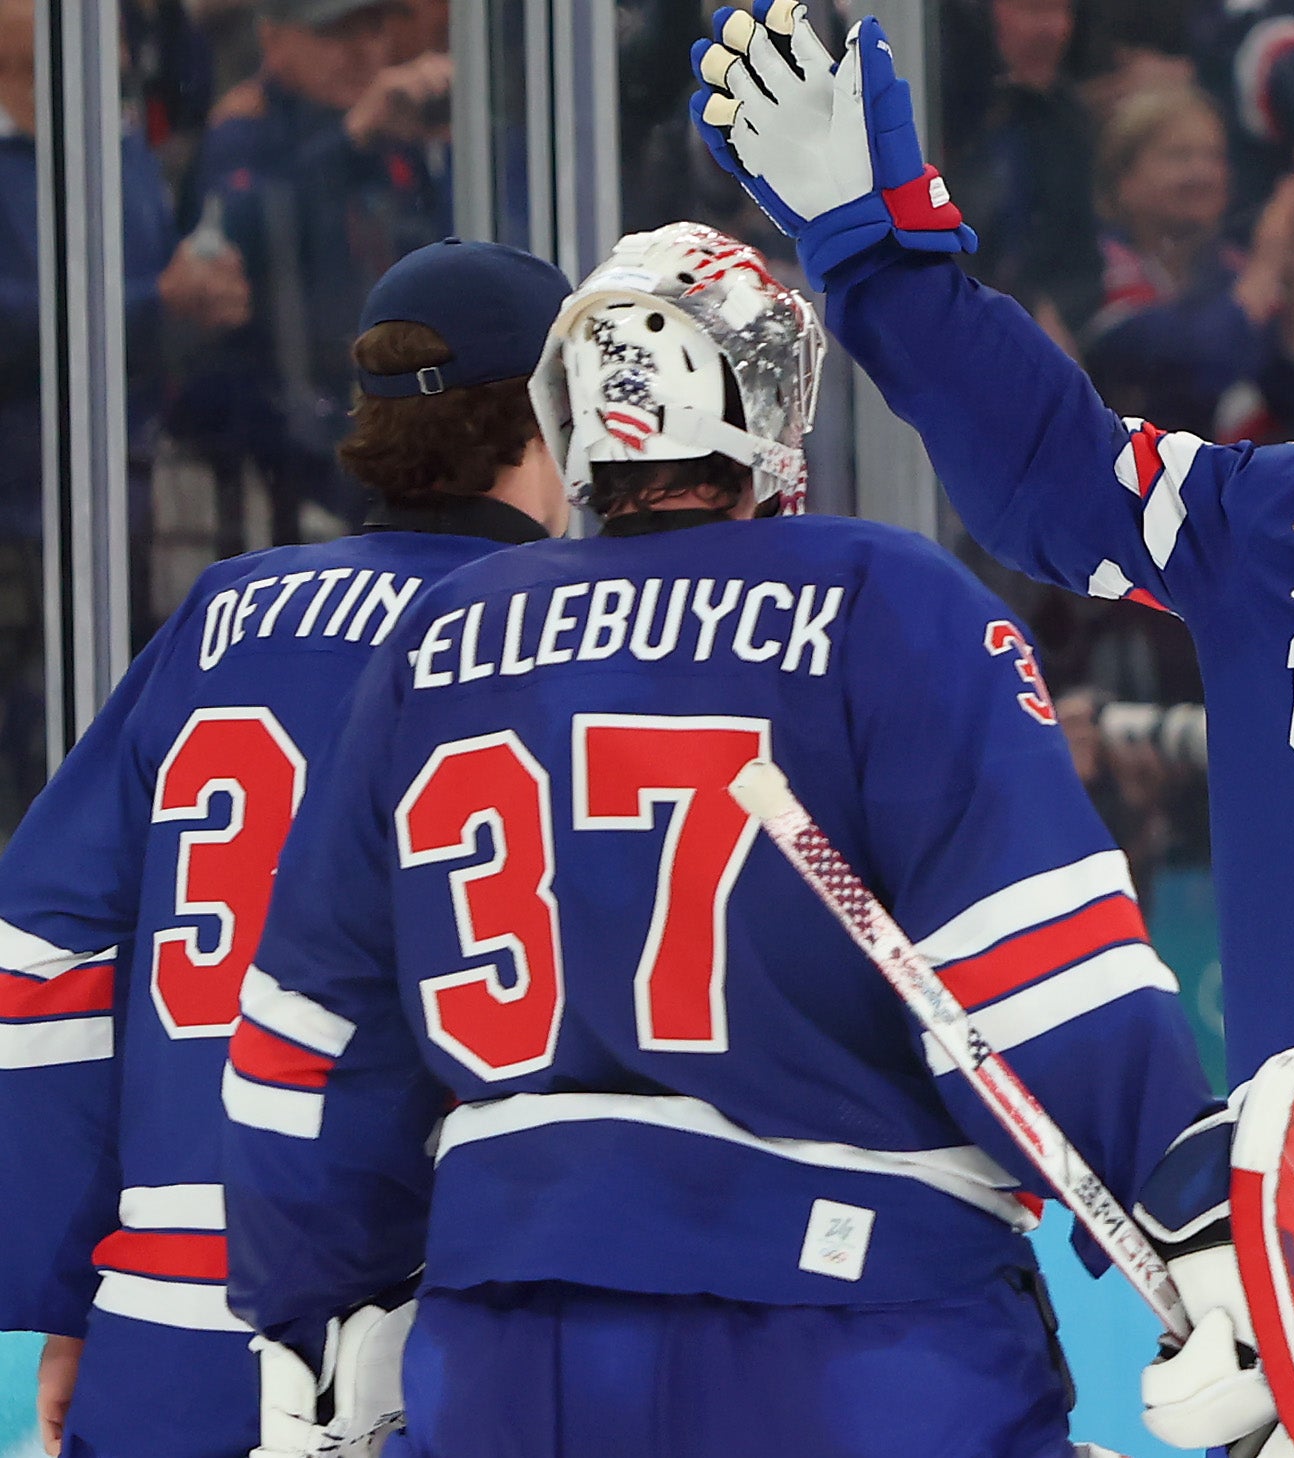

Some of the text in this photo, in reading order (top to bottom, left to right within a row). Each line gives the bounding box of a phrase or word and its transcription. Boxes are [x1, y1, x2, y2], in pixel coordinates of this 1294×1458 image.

[199, 567, 423, 671] OETTIN
[407, 578, 844, 690] ELLEBUYCK
[394, 712, 771, 1082] 37
